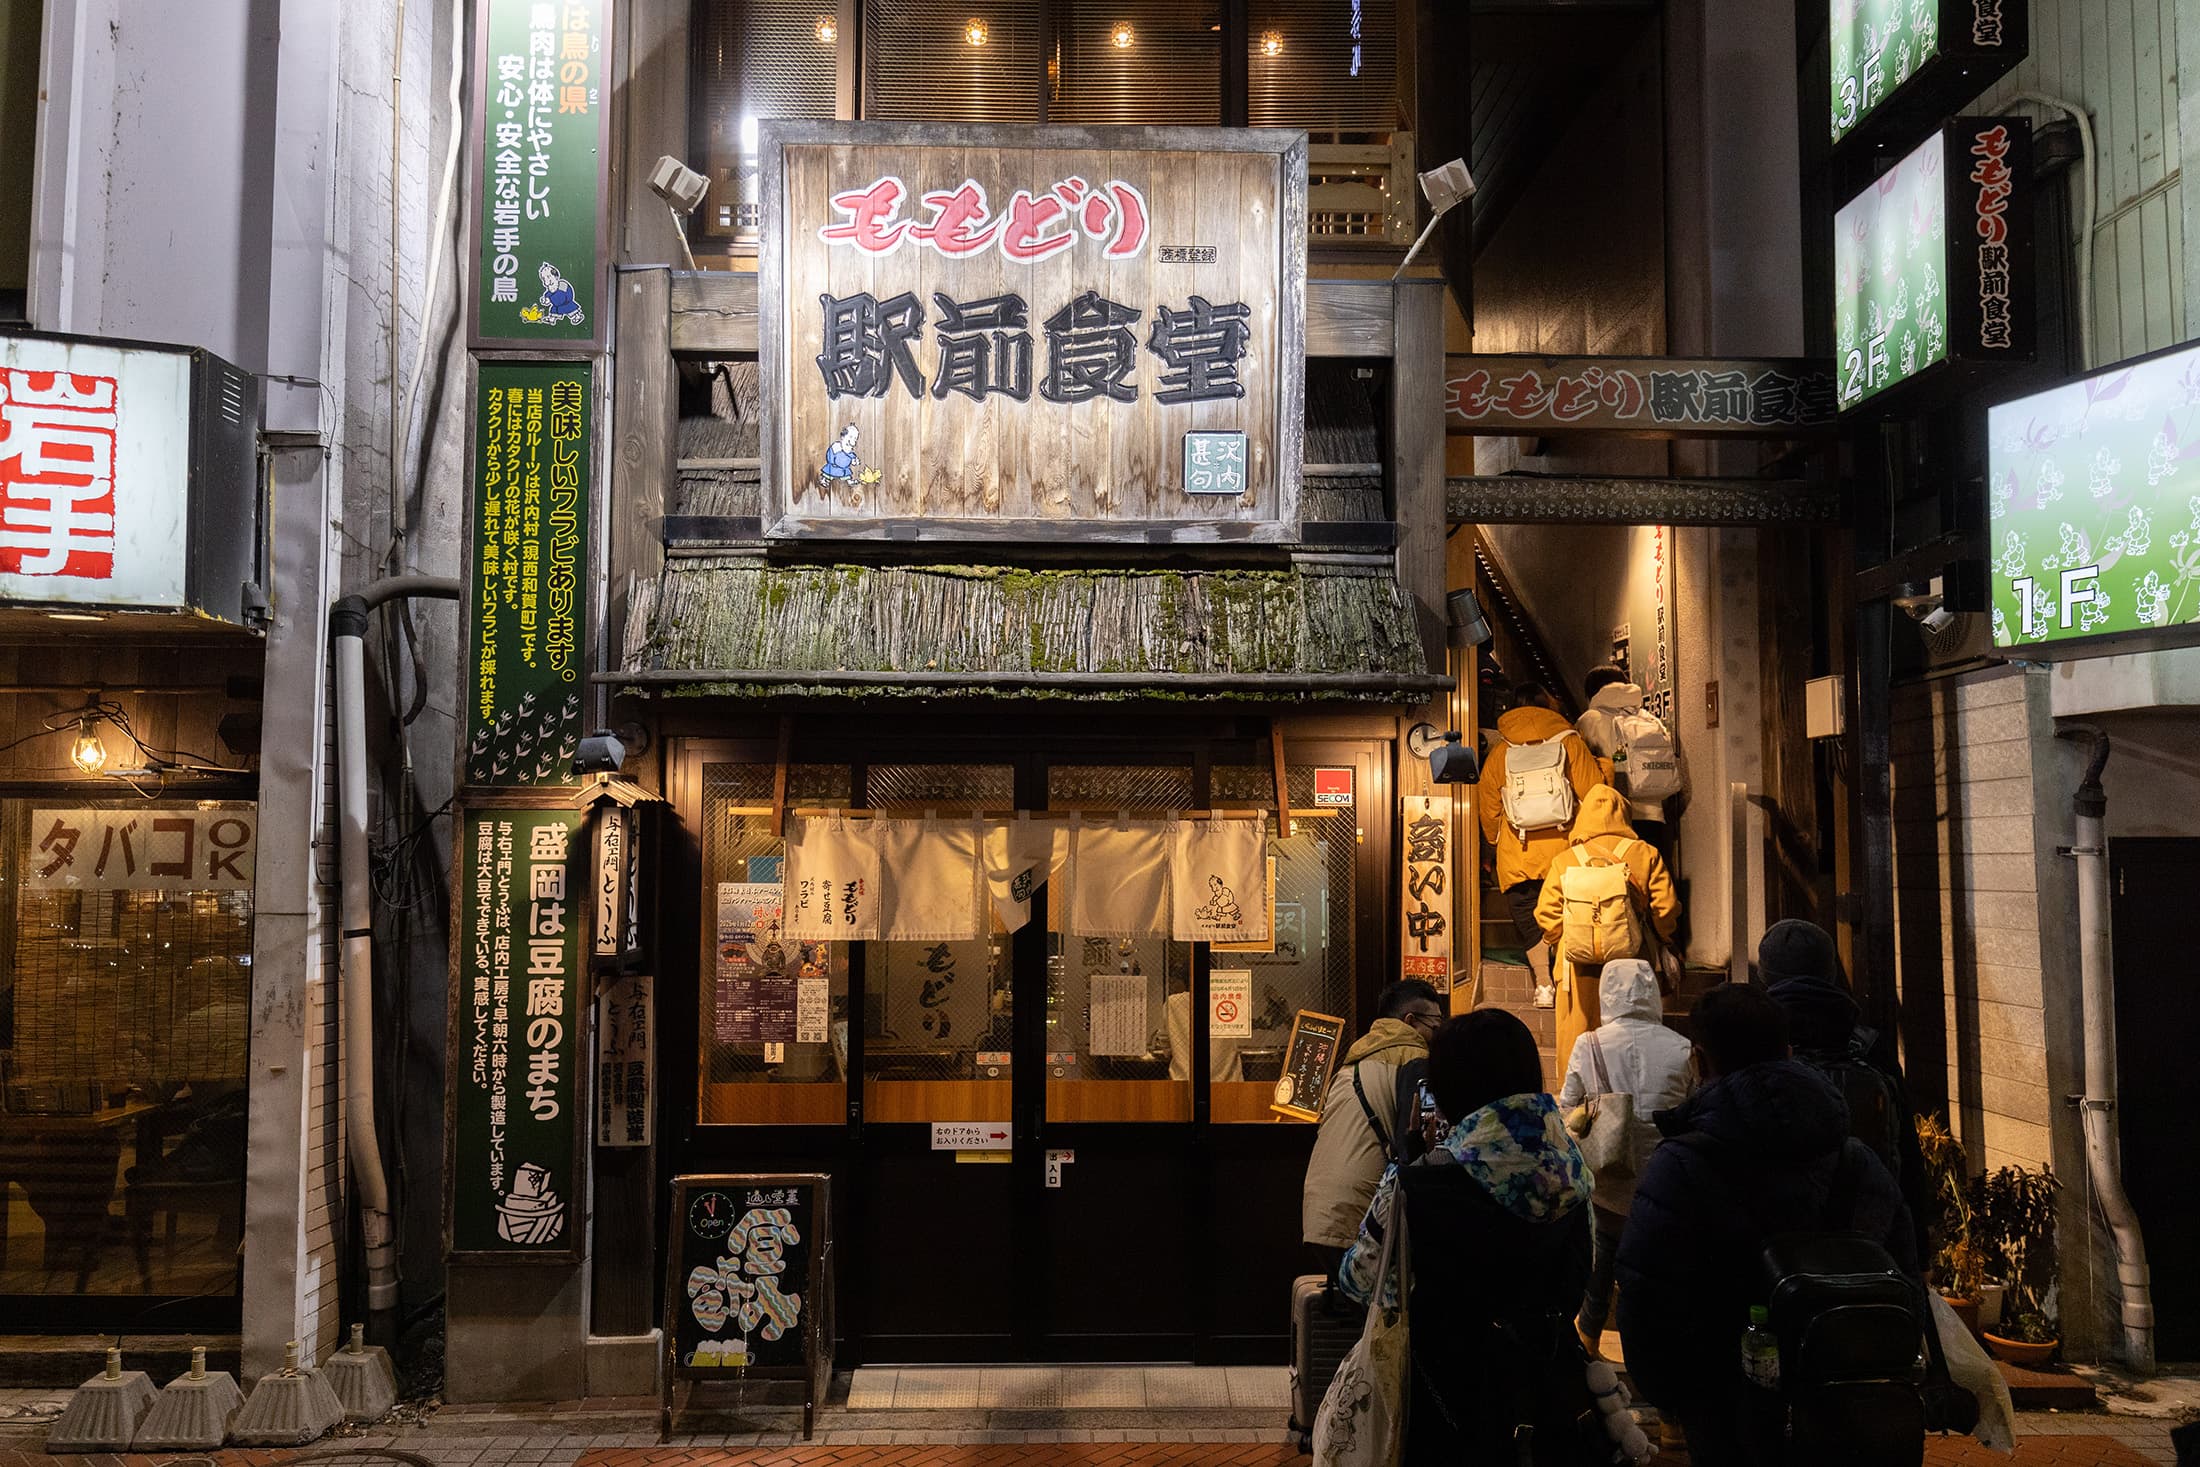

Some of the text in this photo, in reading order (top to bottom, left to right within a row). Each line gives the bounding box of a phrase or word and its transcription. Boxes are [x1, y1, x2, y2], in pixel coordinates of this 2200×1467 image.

[1837, 48, 1881, 129] 3F
[491, 54, 525, 303] 安心・安全な岩手の鳥
[817, 176, 1148, 264] ももどり
[817, 290, 1252, 406] 駅前食堂
[1843, 331, 1886, 399] 2F
[502, 388, 524, 610] 春にはカタクリの花が咲く村です。
[546, 381, 582, 682] 美味しいワラビあります。
[479, 387, 503, 726] カタクリから少し遅れて美味しいワラビが採れます。
[2011, 564, 2099, 635] 1F
[1317, 794, 1350, 803] SECOM
[38, 818, 250, 880] タバコ OK
[800, 880, 808, 909] ワラビ
[822, 880, 832, 925] 寄せ豆腐
[472, 821, 494, 1088] 豆腐は大豆でできている、実感してください。
[526, 822, 568, 1121] 盛岡は豆腐のまち
[936, 1127, 981, 1135] 右のドアから
[936, 1137, 989, 1145] お入りください
[1049, 1152, 1058, 1184] 出入口
[700, 1218, 724, 1229] Open
